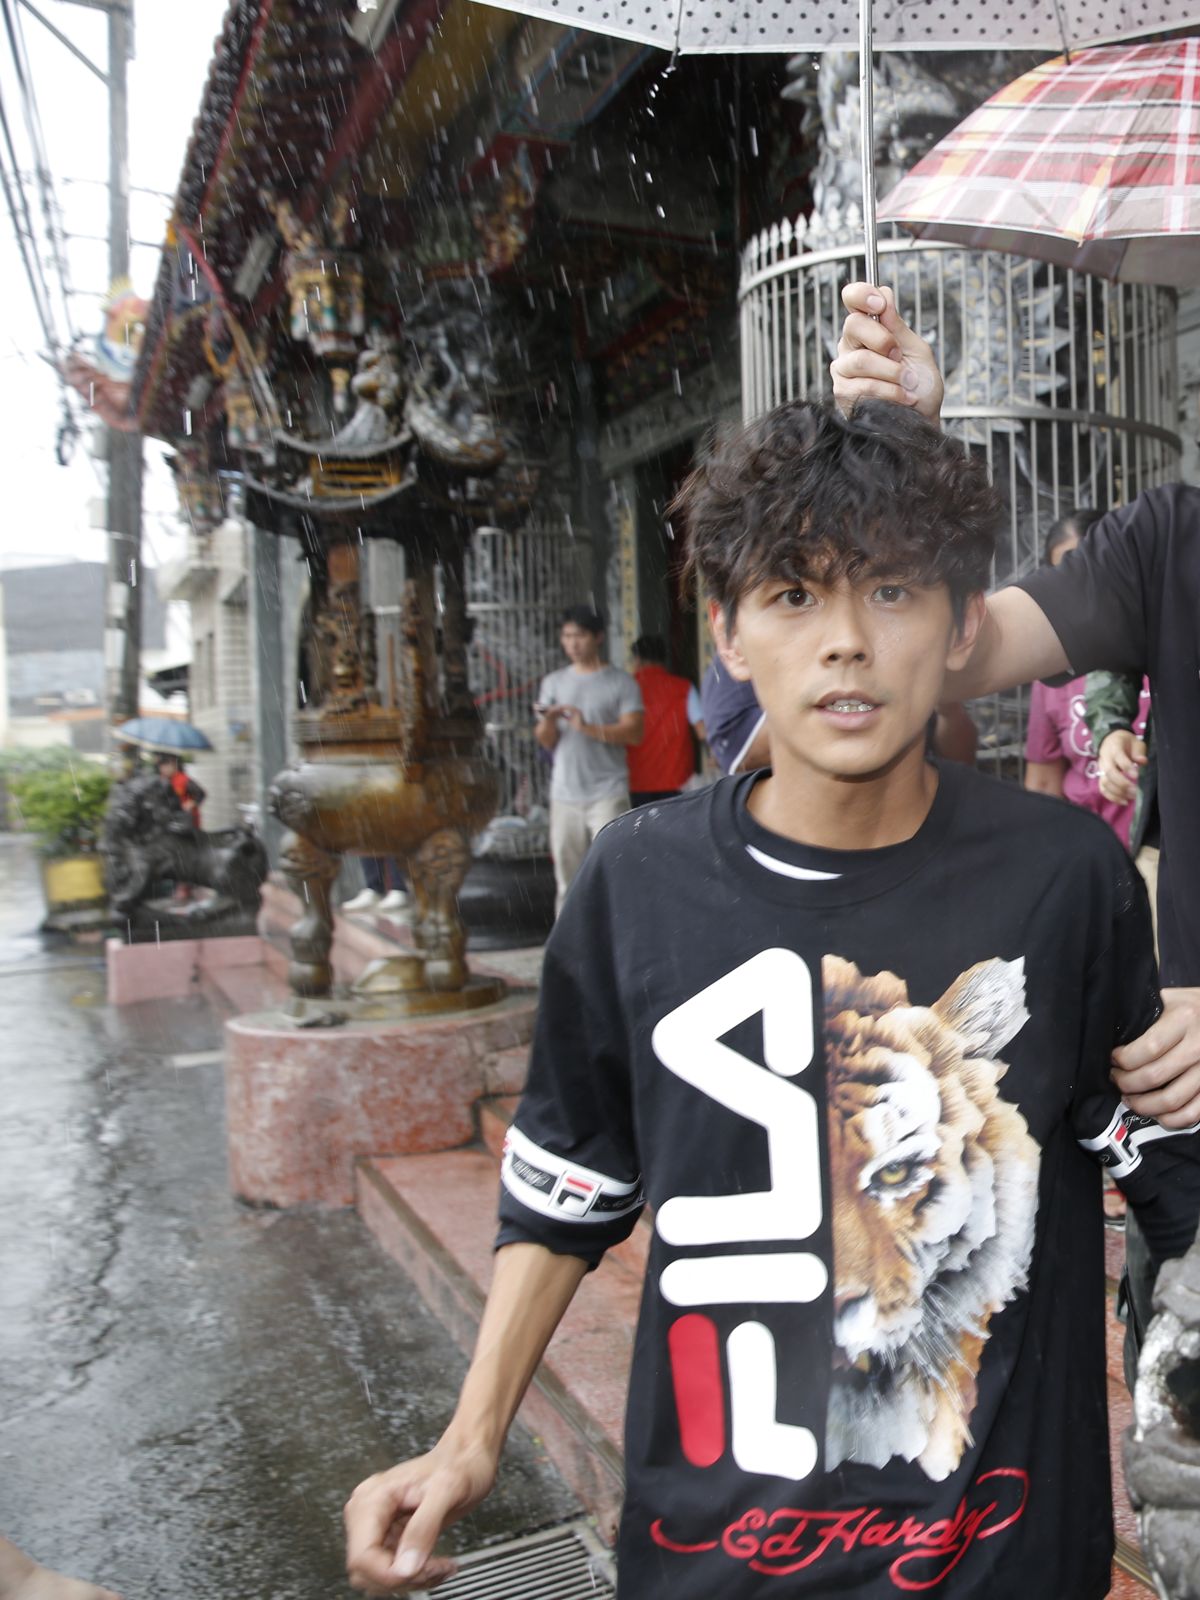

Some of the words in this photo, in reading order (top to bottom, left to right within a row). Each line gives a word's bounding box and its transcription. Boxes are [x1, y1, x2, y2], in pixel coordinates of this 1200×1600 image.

[652, 947, 829, 1481] FILA
[721, 1507, 808, 1560] Ed
[760, 1468, 1029, 1591] Hardy
